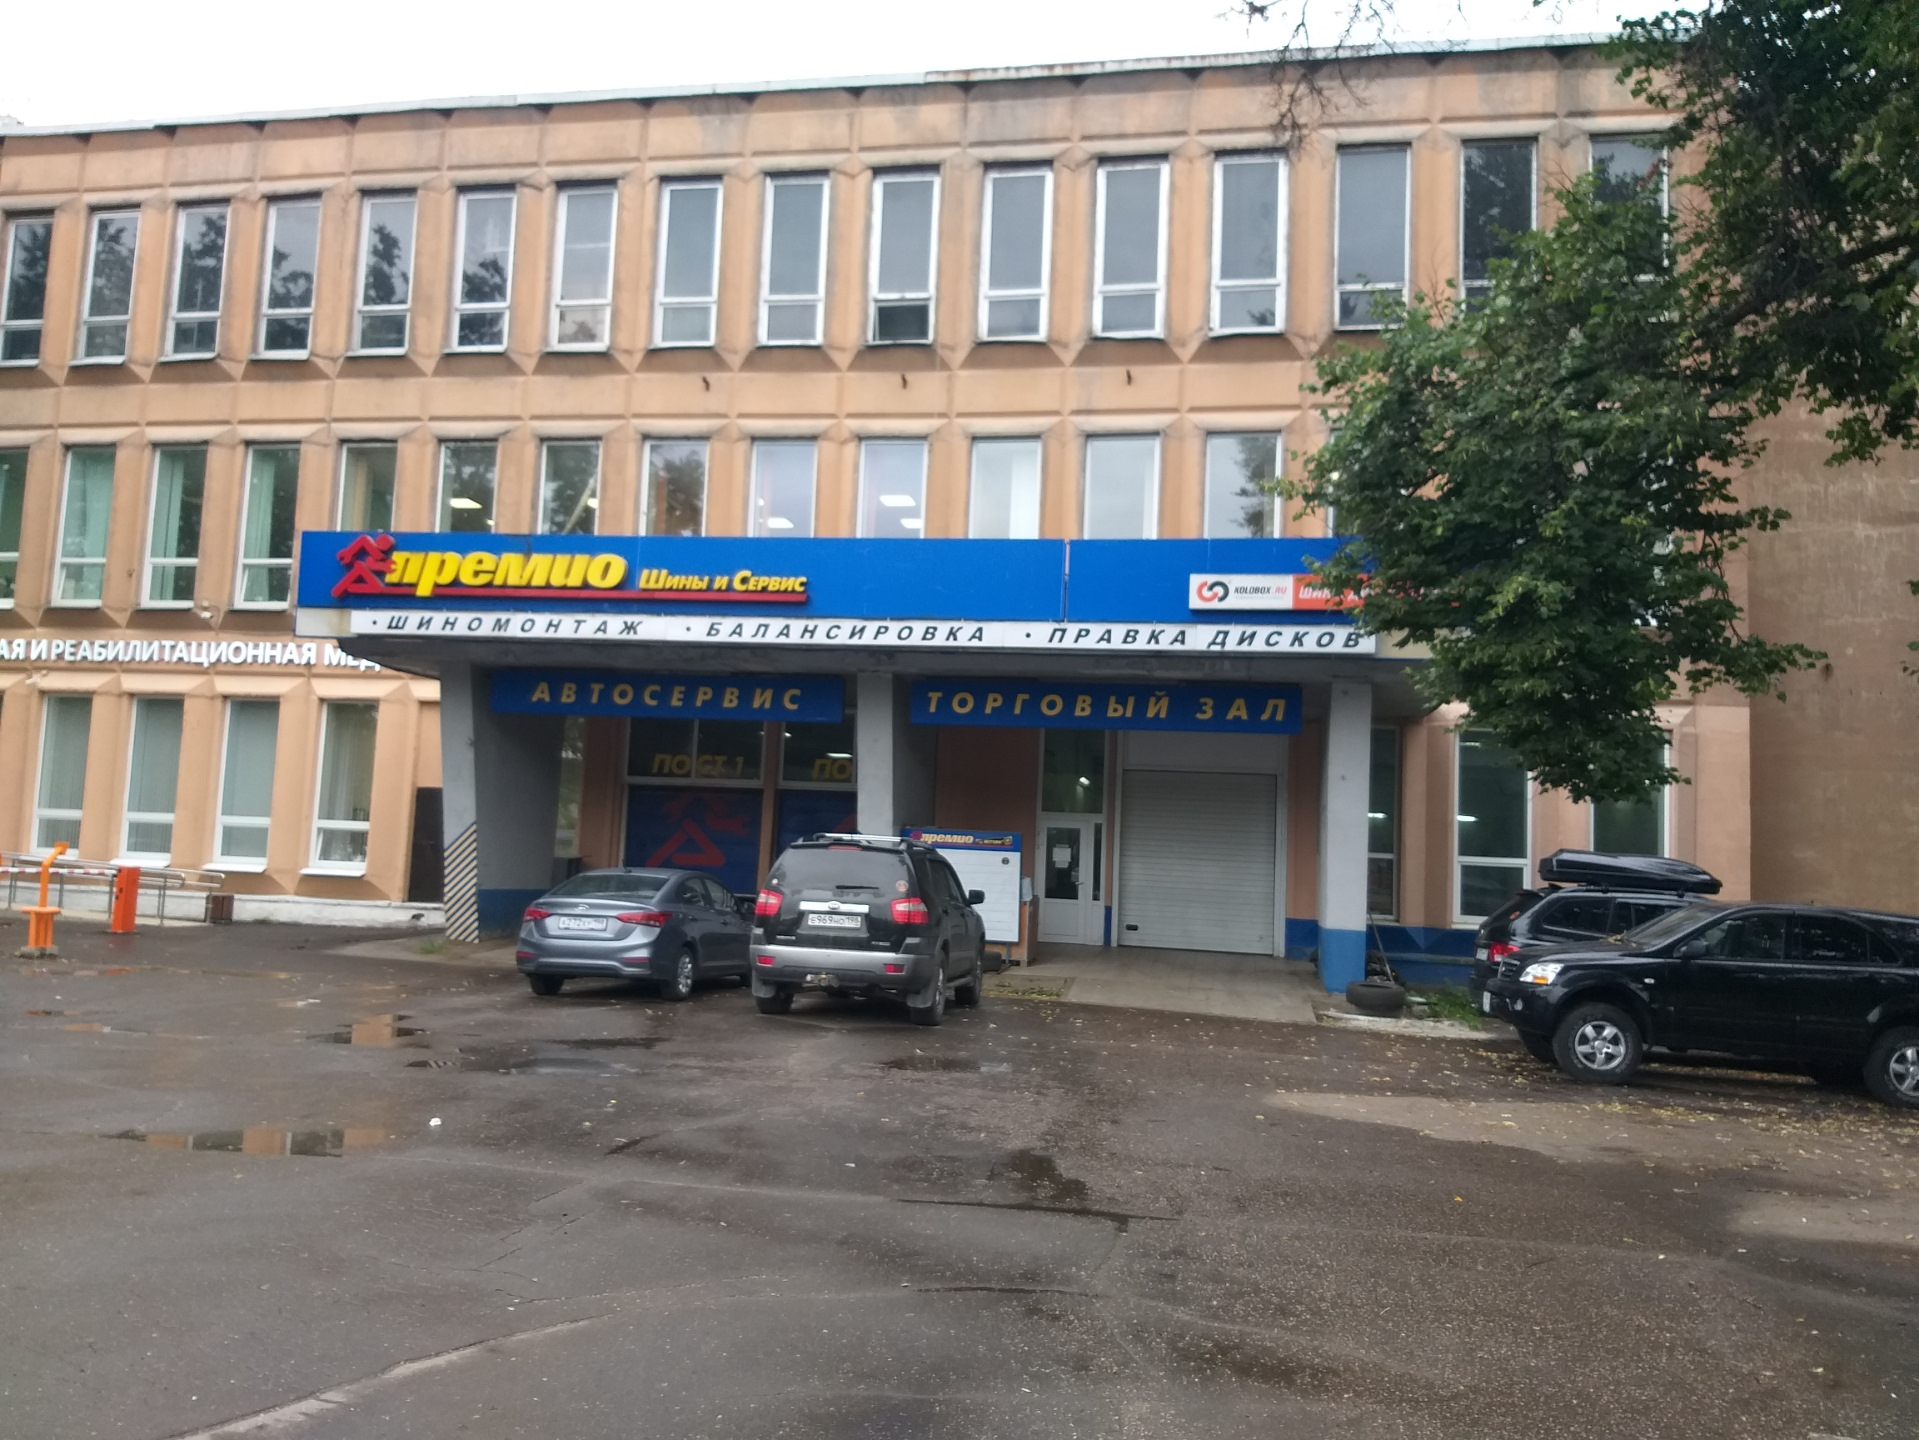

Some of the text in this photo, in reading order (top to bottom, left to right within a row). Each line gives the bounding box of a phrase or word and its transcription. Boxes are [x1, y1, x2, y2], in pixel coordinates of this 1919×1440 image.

[384, 551, 628, 597] премио
[387, 616, 1361, 650] ШИНОМОНТАЖ БАЛАНСИРОВКА ПРАВКА ДИСКОВ
[30, 638, 49, 661] И
[50, 639, 318, 668] РЕАБИЛИТАЦИОННАЯ
[531, 681, 802, 710] АВТОСЕРВИС
[927, 691, 1286, 722] ТОРГОВЫЙ ЗАЛ
